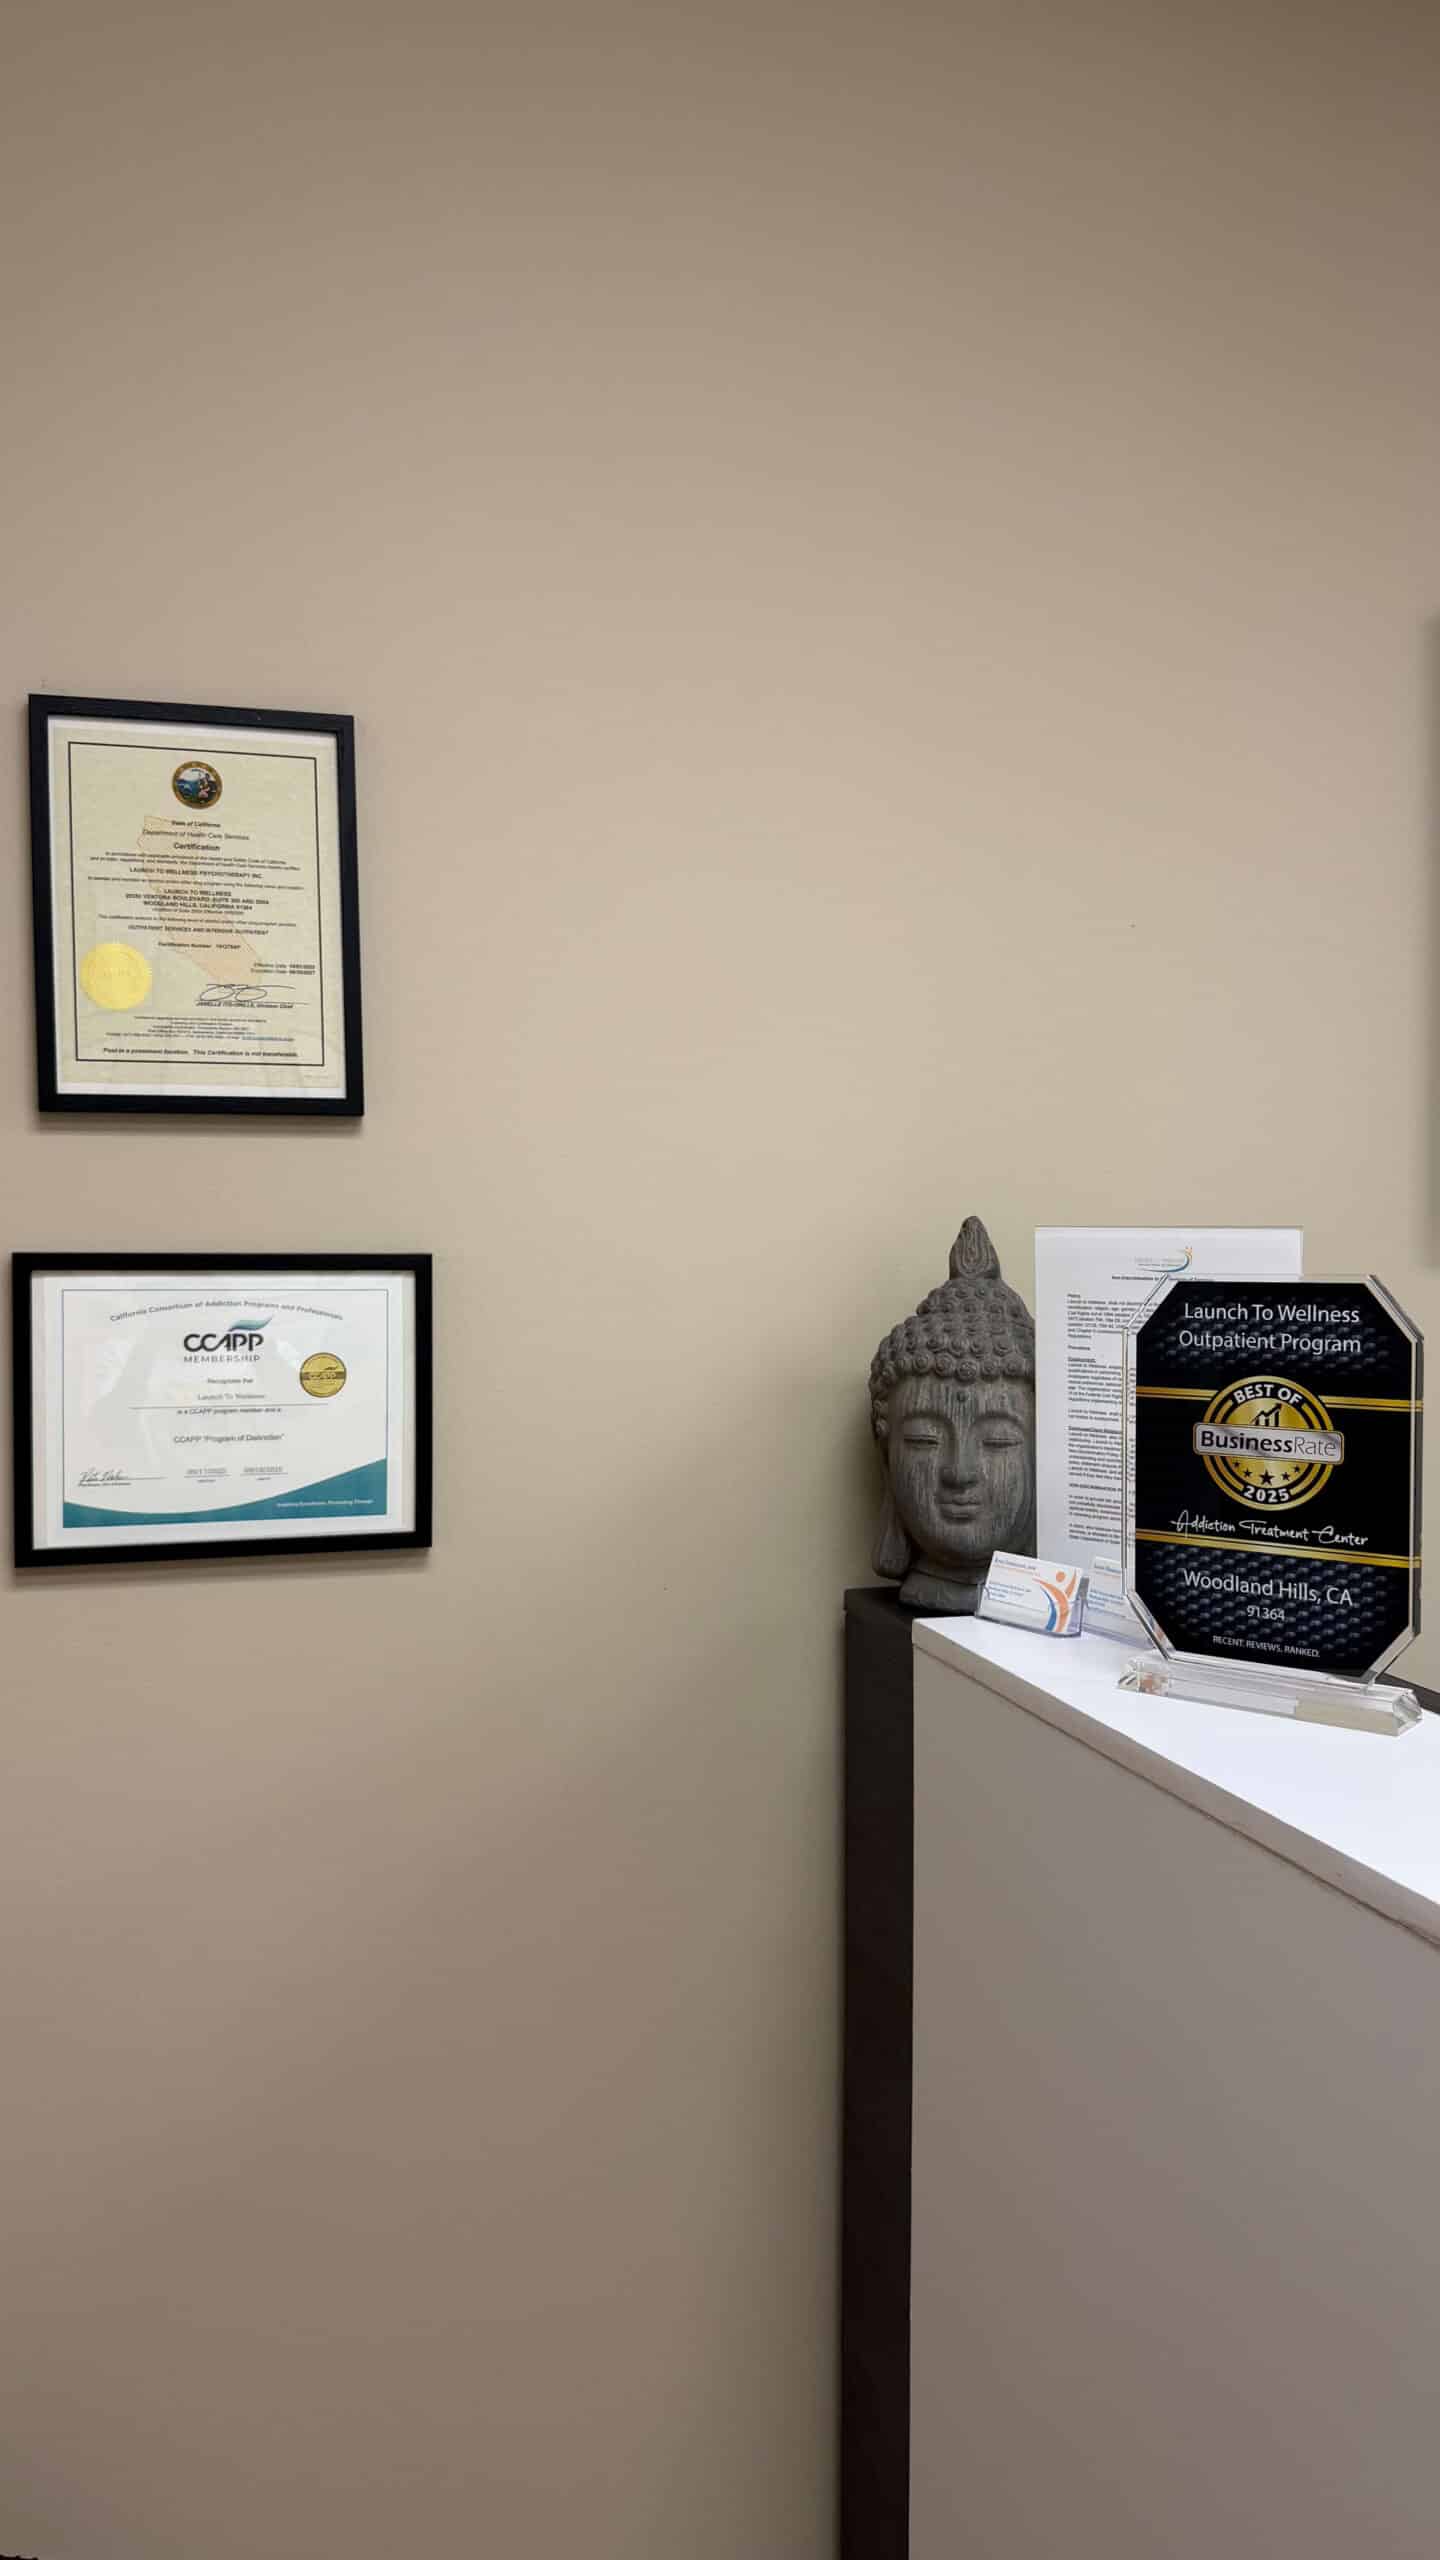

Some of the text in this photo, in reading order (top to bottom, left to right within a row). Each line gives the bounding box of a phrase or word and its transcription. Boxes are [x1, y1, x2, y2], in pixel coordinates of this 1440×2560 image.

[173, 841, 221, 851] Certification
[110, 1309, 147, 1322] California
[243, 1299, 280, 1309] Programs
[1184, 1302, 1361, 1323] Launch To Wellness
[183, 1332, 265, 1353] CCAPP
[1178, 1330, 1362, 1355] Outpatient Program
[183, 1353, 262, 1364] MEMBERSHIP
[1233, 1384, 1303, 1405] BEST OF
[173, 1435, 202, 1443] CCAPP
[1200, 1430, 1338, 1457] BusinessRate
[1243, 1485, 1290, 1503] 2025
[1168, 1509, 1369, 1546] Addiction Treatment Center
[1183, 1569, 1353, 1607] Woodland Hills, CA
[1246, 1604, 1286, 1622] 91364
[1212, 1635, 1321, 1658] RECENT. REVIEWS. RANKED.
